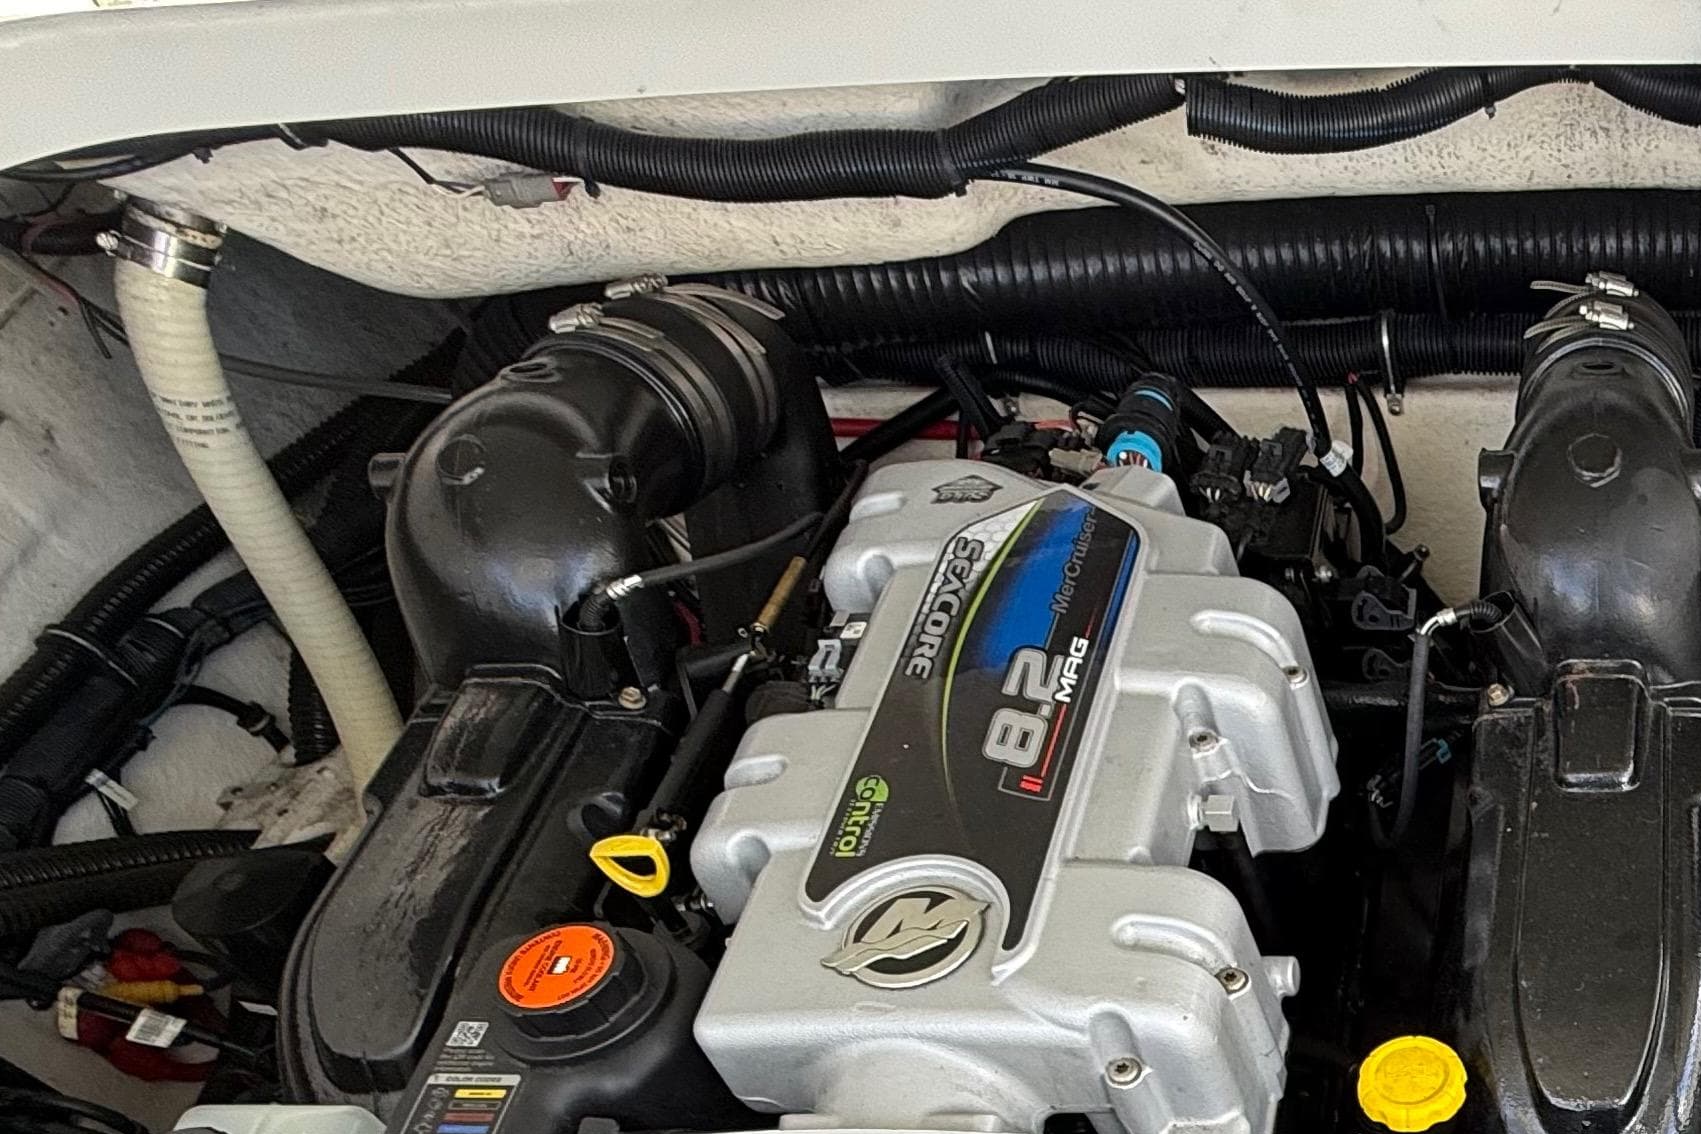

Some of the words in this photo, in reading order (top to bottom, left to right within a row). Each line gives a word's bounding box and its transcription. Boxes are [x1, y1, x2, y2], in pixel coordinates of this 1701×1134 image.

[904, 536, 984, 679] SEACORE
[1051, 514, 1097, 616] MerCruiser
[982, 647, 1064, 768] 8.2
[1055, 636, 1090, 704] MAG
[835, 775, 880, 857] control
